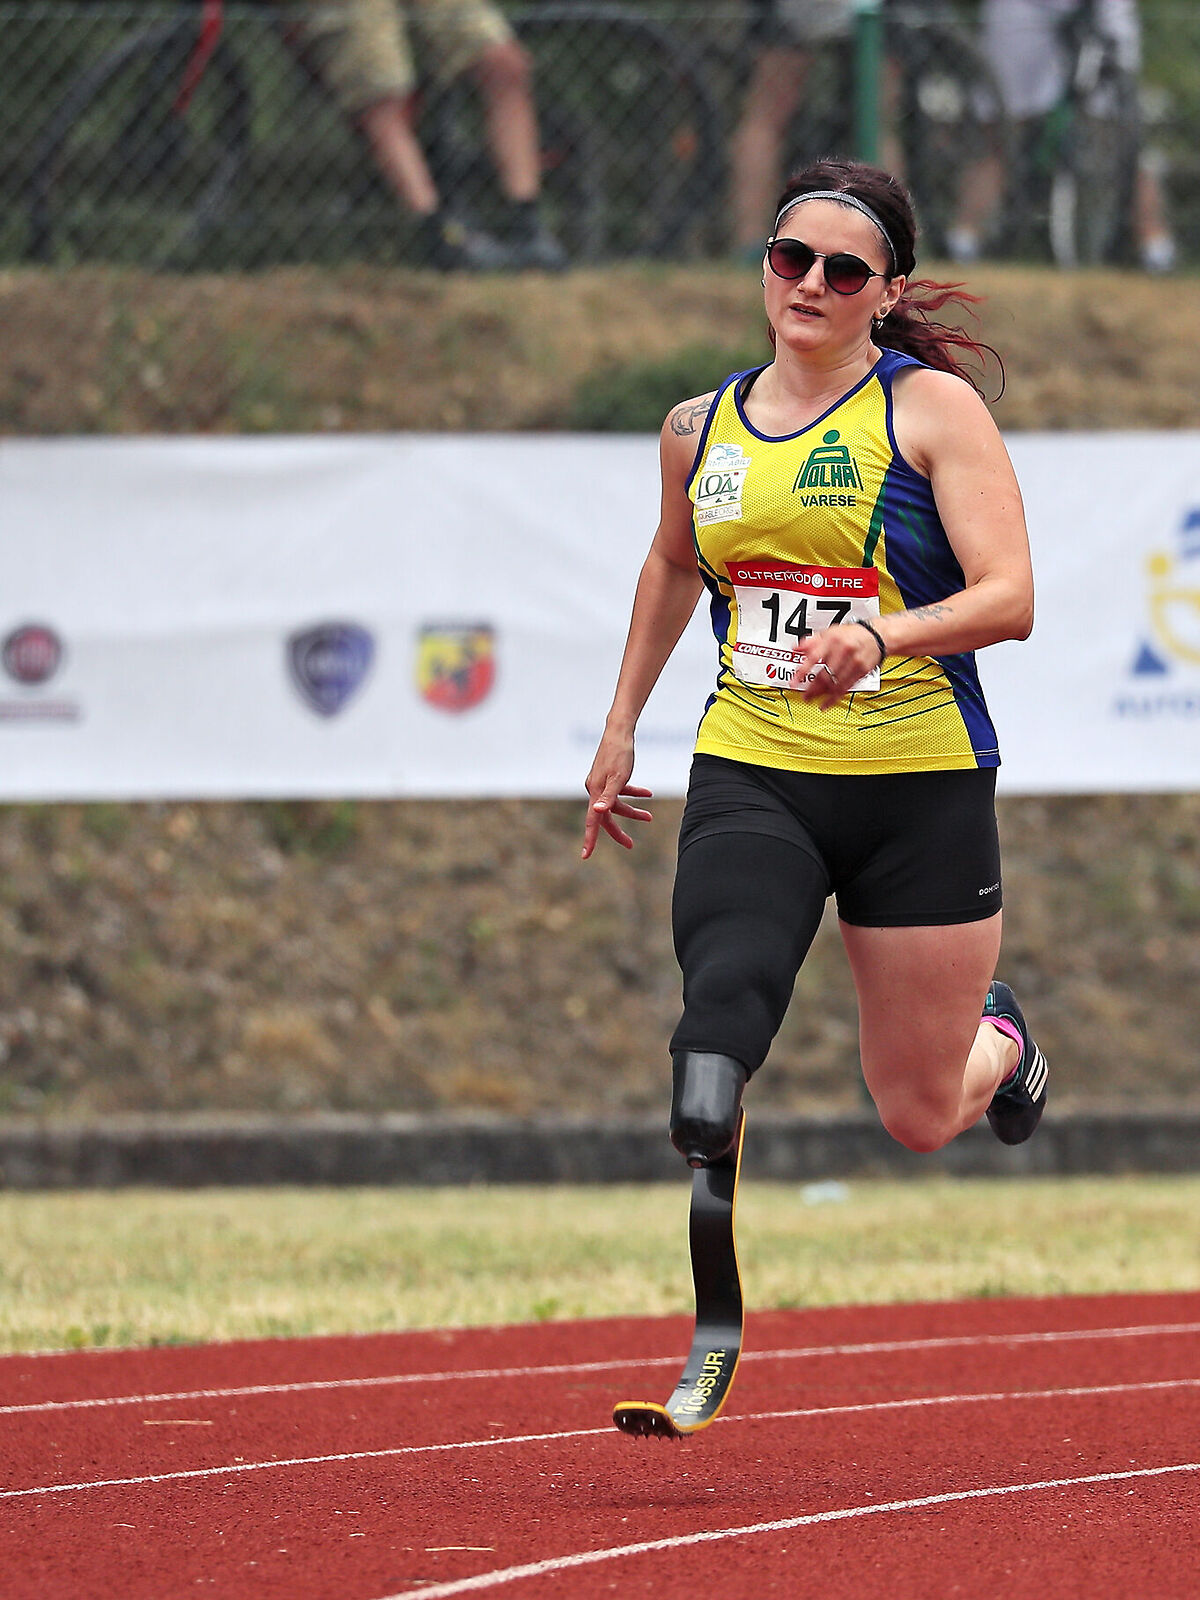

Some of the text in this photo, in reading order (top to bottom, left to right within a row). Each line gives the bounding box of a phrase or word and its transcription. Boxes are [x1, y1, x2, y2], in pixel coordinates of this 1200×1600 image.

[800, 494, 857, 508] VARESE
[761, 592, 852, 645] 147
[737, 643, 792, 661] CONCESIO
